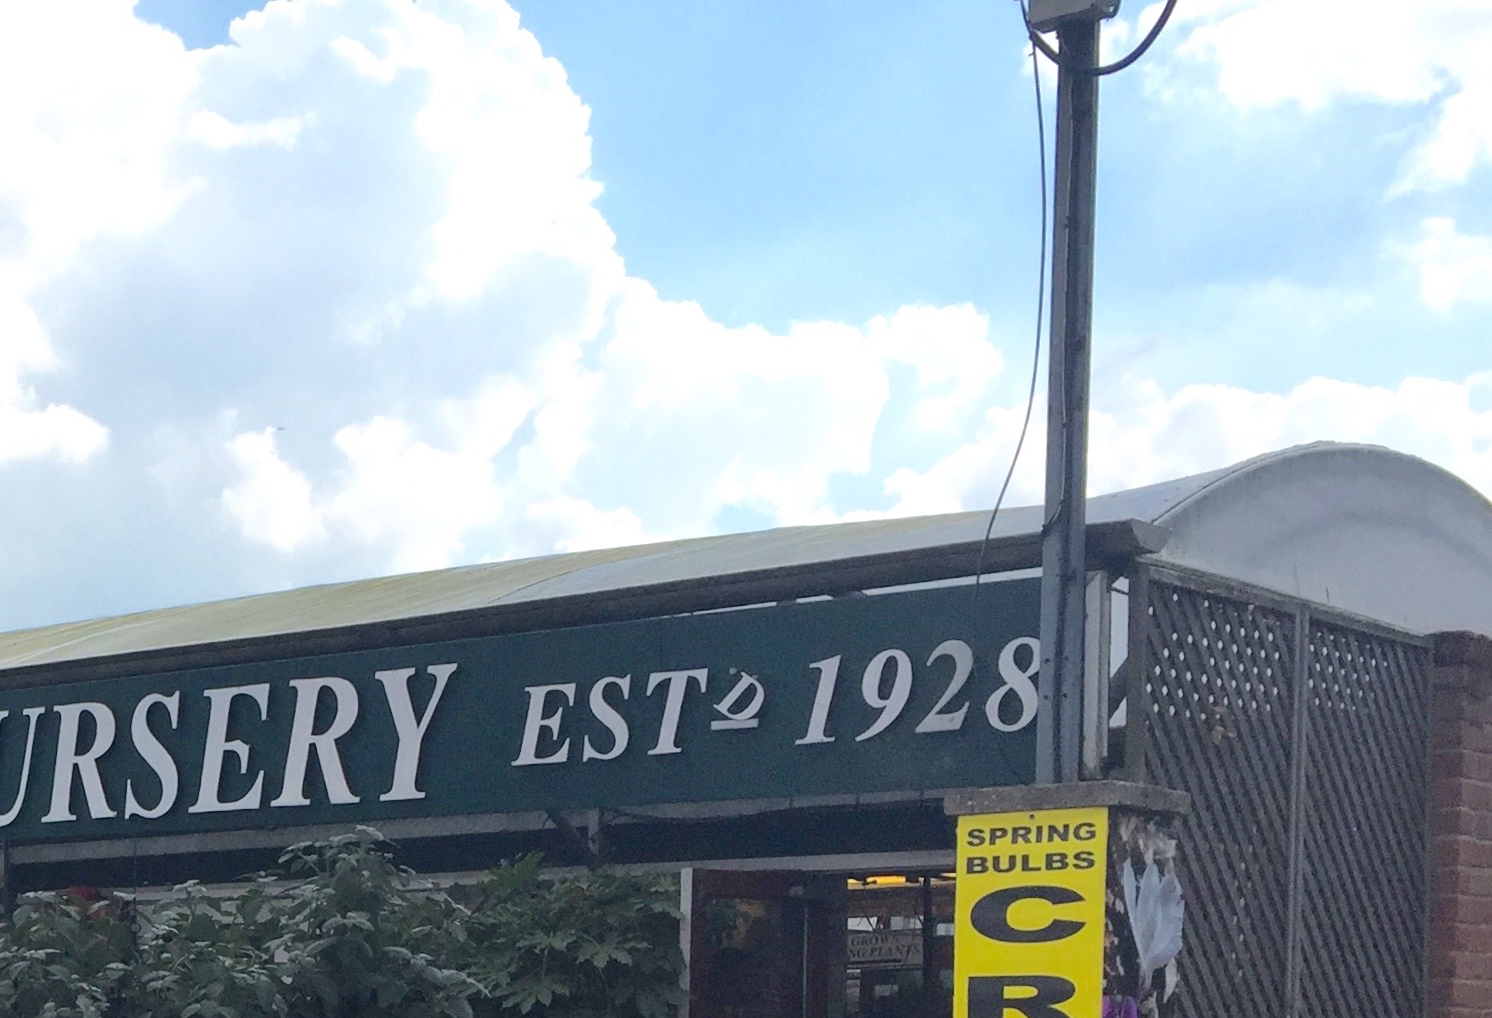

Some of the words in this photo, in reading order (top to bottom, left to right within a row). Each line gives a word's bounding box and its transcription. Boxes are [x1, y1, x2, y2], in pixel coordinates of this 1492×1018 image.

[794, 636, 1041, 745] 1928
[967, 822, 1096, 847] SPRING
[966, 851, 1095, 875] BULBS
